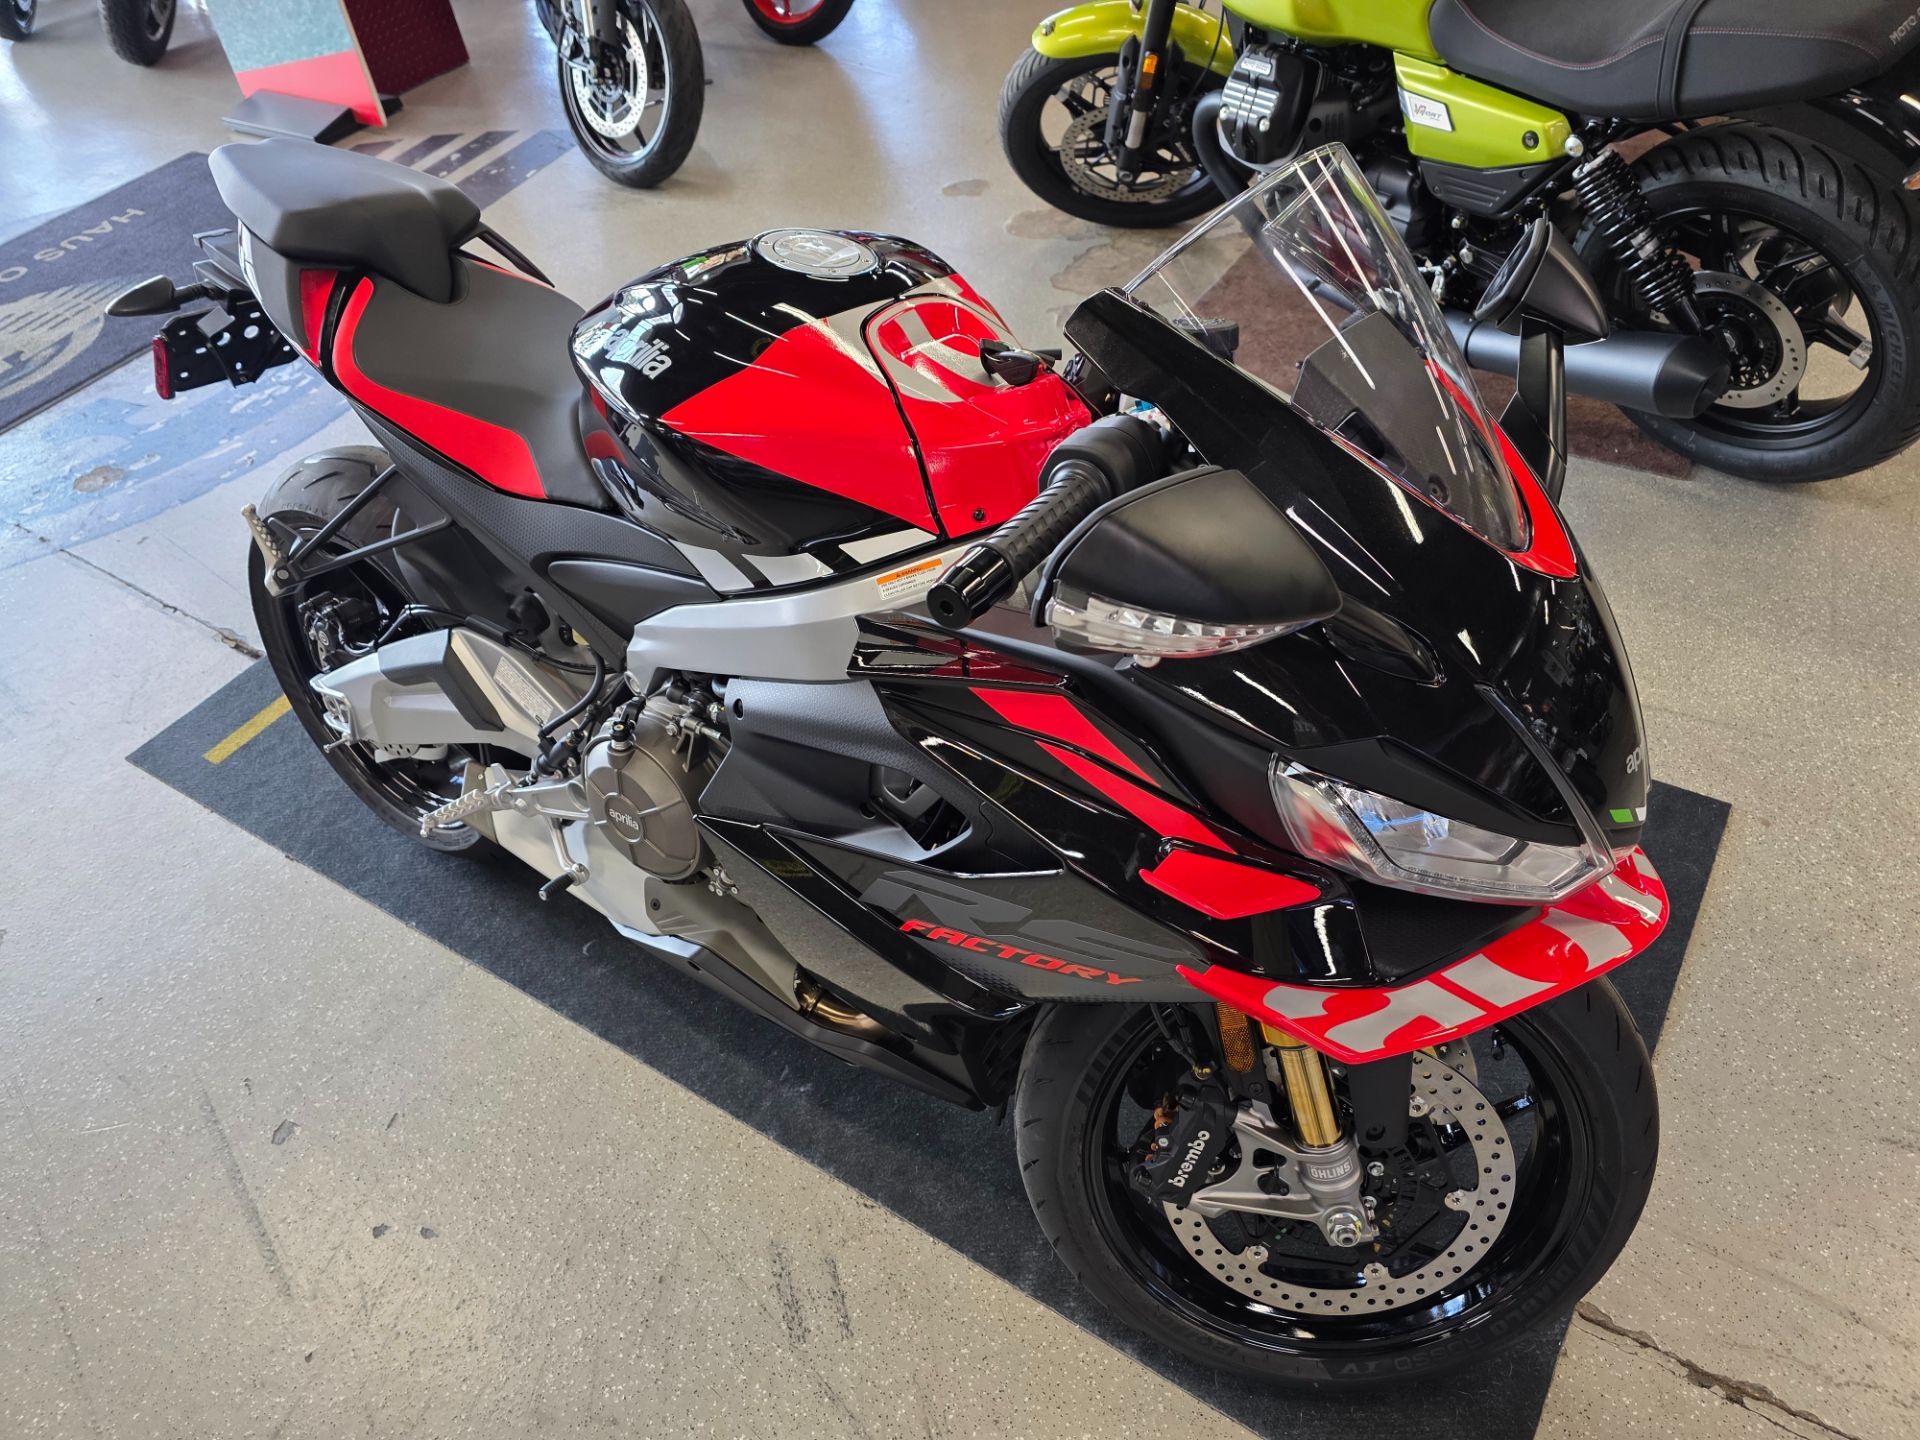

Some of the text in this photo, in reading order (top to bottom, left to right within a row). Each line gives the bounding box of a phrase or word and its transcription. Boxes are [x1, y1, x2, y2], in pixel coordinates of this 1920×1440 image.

[33, 207, 145, 262] HAUS
[603, 328, 673, 381] aprilia
[608, 807, 639, 831] aprilia
[898, 917, 1146, 987] FACTORY
[1167, 1130, 1210, 1188] brembo
